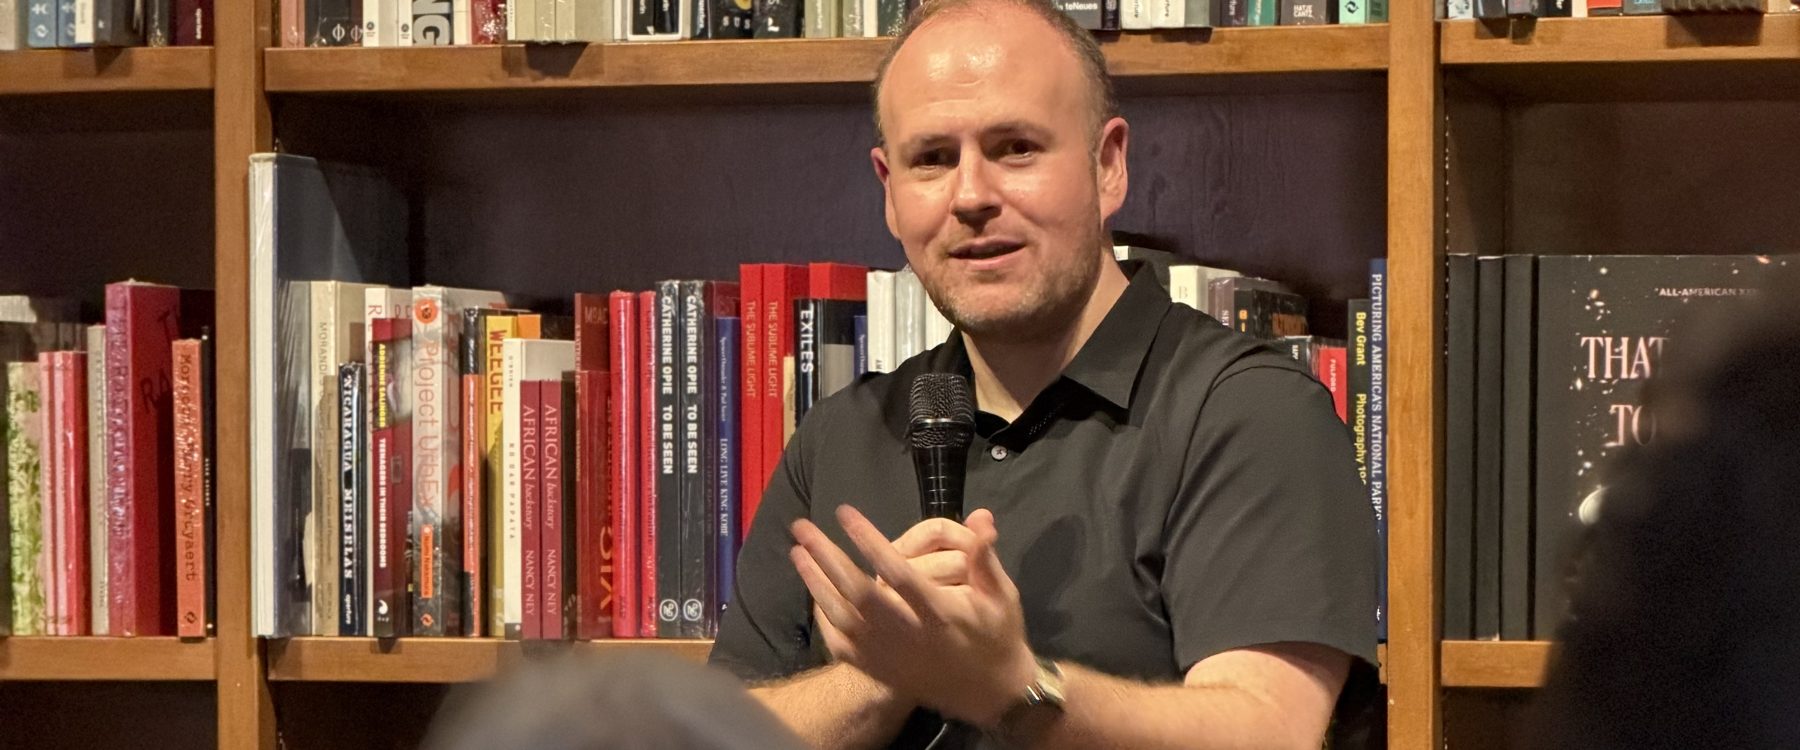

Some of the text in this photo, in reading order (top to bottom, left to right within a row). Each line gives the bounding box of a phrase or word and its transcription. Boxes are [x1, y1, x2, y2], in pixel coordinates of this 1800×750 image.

[800, 310, 813, 373] EXILES
[1356, 312, 1366, 333] Bev
[1372, 273, 1382, 342] PICTURING
[415, 341, 440, 427] Project
[489, 329, 507, 415] WEEGEE
[661, 296, 674, 475] CATHERINE OPIE TO BE SEEN
[686, 296, 698, 474] CATHERINE OPIE TO BE SEEN
[746, 301, 756, 398] THE SUBLIME LIGHT
[768, 301, 778, 398] THE SUBLIME LIGHT
[1356, 335, 1366, 365] Grant
[1372, 345, 1382, 411] AMERICA'S
[343, 375, 354, 472] NICARAGUA
[720, 438, 728, 462] LONG
[1354, 393, 1366, 463] Photography
[1372, 415, 1382, 477] NATIONAL
[522, 405, 536, 615] AFRICAN backstory NANCY NEY
[543, 404, 558, 614] AFRICAN backstory NANCY NEY
[720, 464, 728, 485] LIVE
[720, 487, 728, 511] KING
[343, 488, 354, 580] MEISELAS
